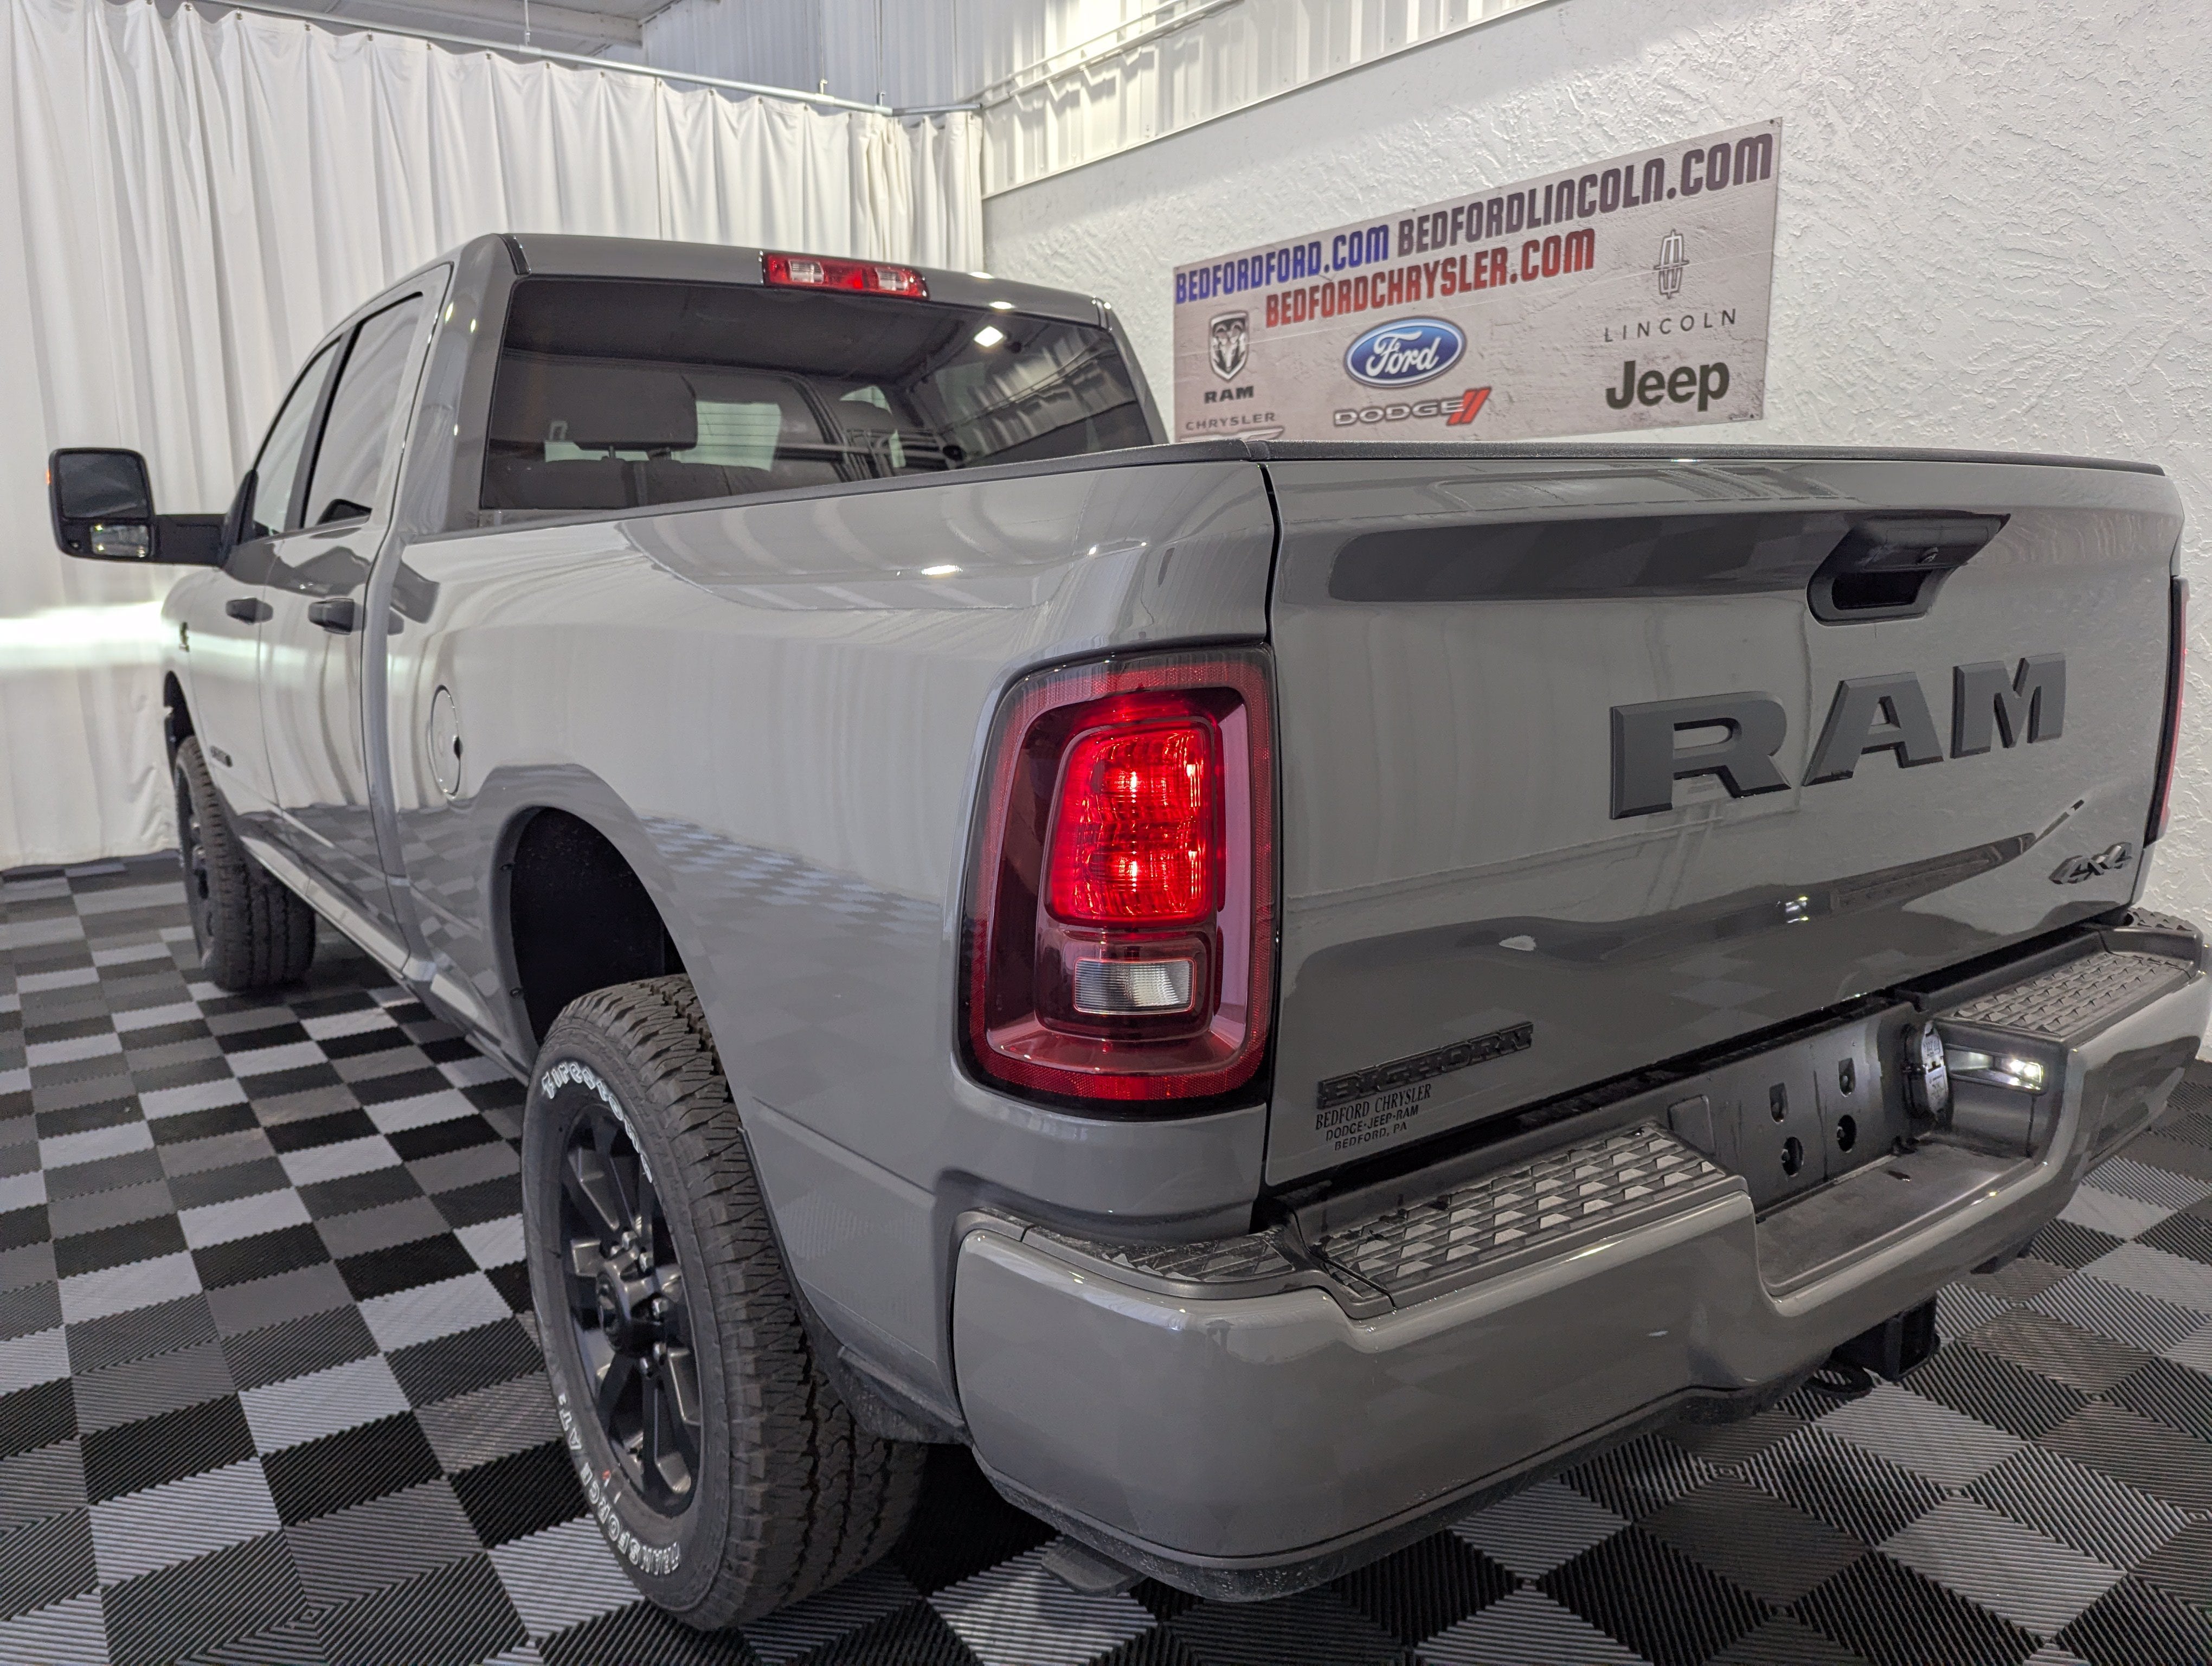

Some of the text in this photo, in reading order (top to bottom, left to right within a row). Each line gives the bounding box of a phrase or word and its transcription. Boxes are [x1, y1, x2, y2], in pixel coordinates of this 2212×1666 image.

[1175, 132, 1773, 305] BEDFORDFORD.COM BEDFORDLINCOLN.COM
[1265, 228, 1595, 329] BEDFORDCHRYSLER.COM
[1604, 308, 1736, 343] LINCOLN
[1365, 330, 1442, 376] Ford
[1204, 385, 1255, 404] RAM
[1605, 360, 1730, 413] Jeep
[1185, 412, 1276, 432] CHRYSLER
[1334, 396, 1464, 427] DODGE
[1609, 652, 2066, 820] RAM
[1315, 1084, 1432, 1130] BEDFORD CHRYSLER
[1334, 1121, 1408, 1151] BEDFORD, PA
